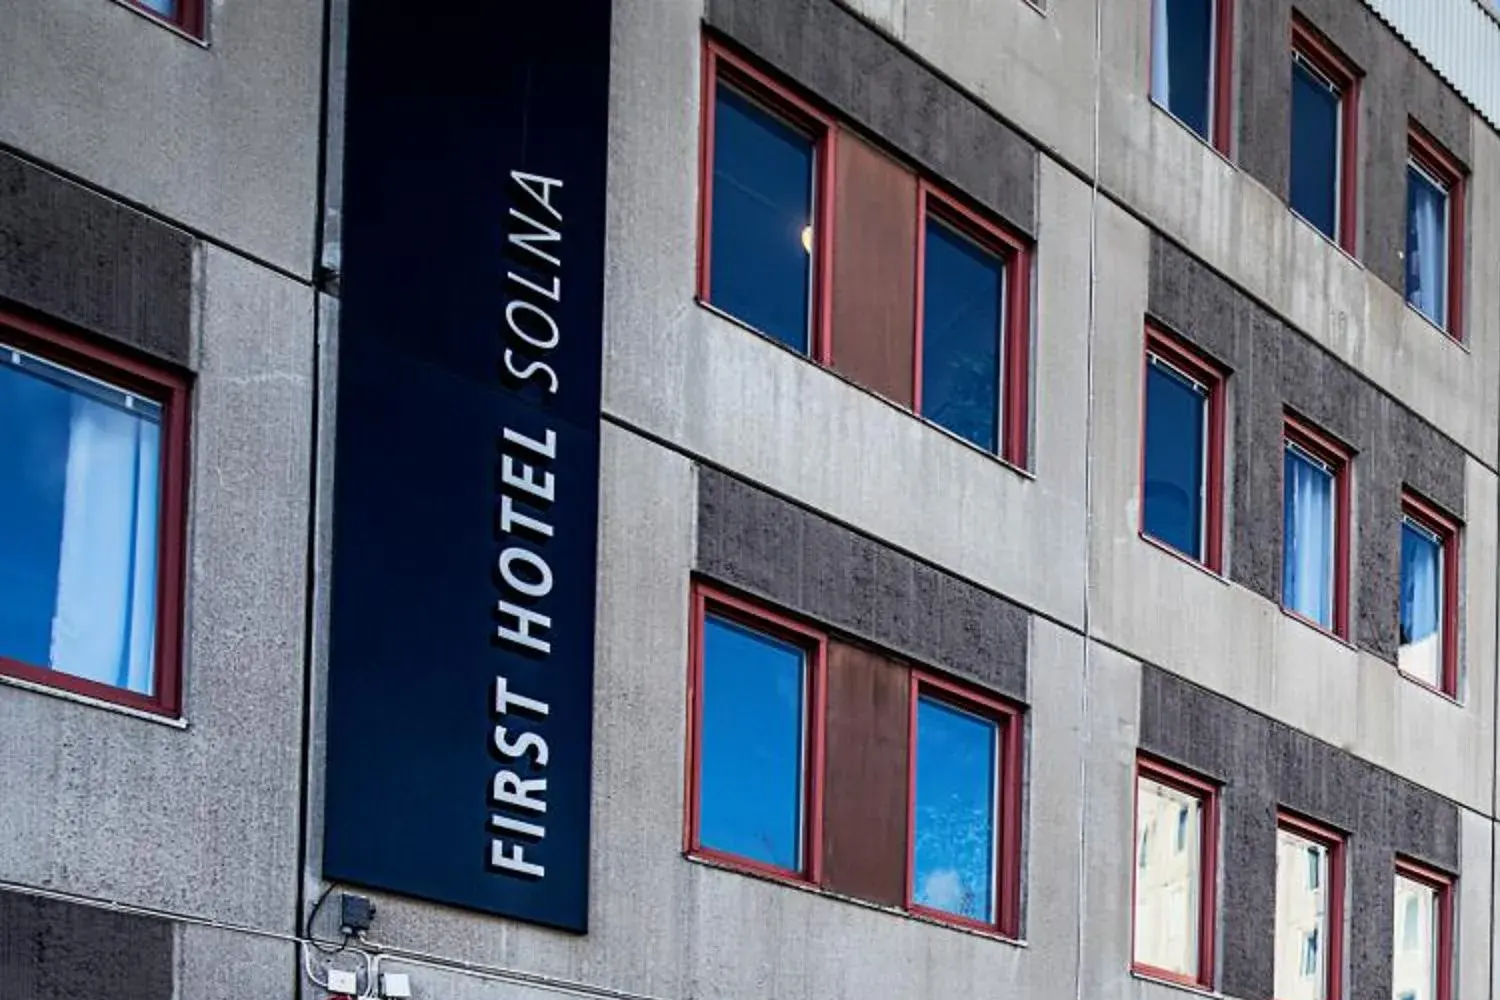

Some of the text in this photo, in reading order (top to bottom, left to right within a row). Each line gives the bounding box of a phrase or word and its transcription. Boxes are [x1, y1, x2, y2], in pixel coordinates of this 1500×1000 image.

[491, 169, 563, 878] FIRST HOTEL SOLNA
